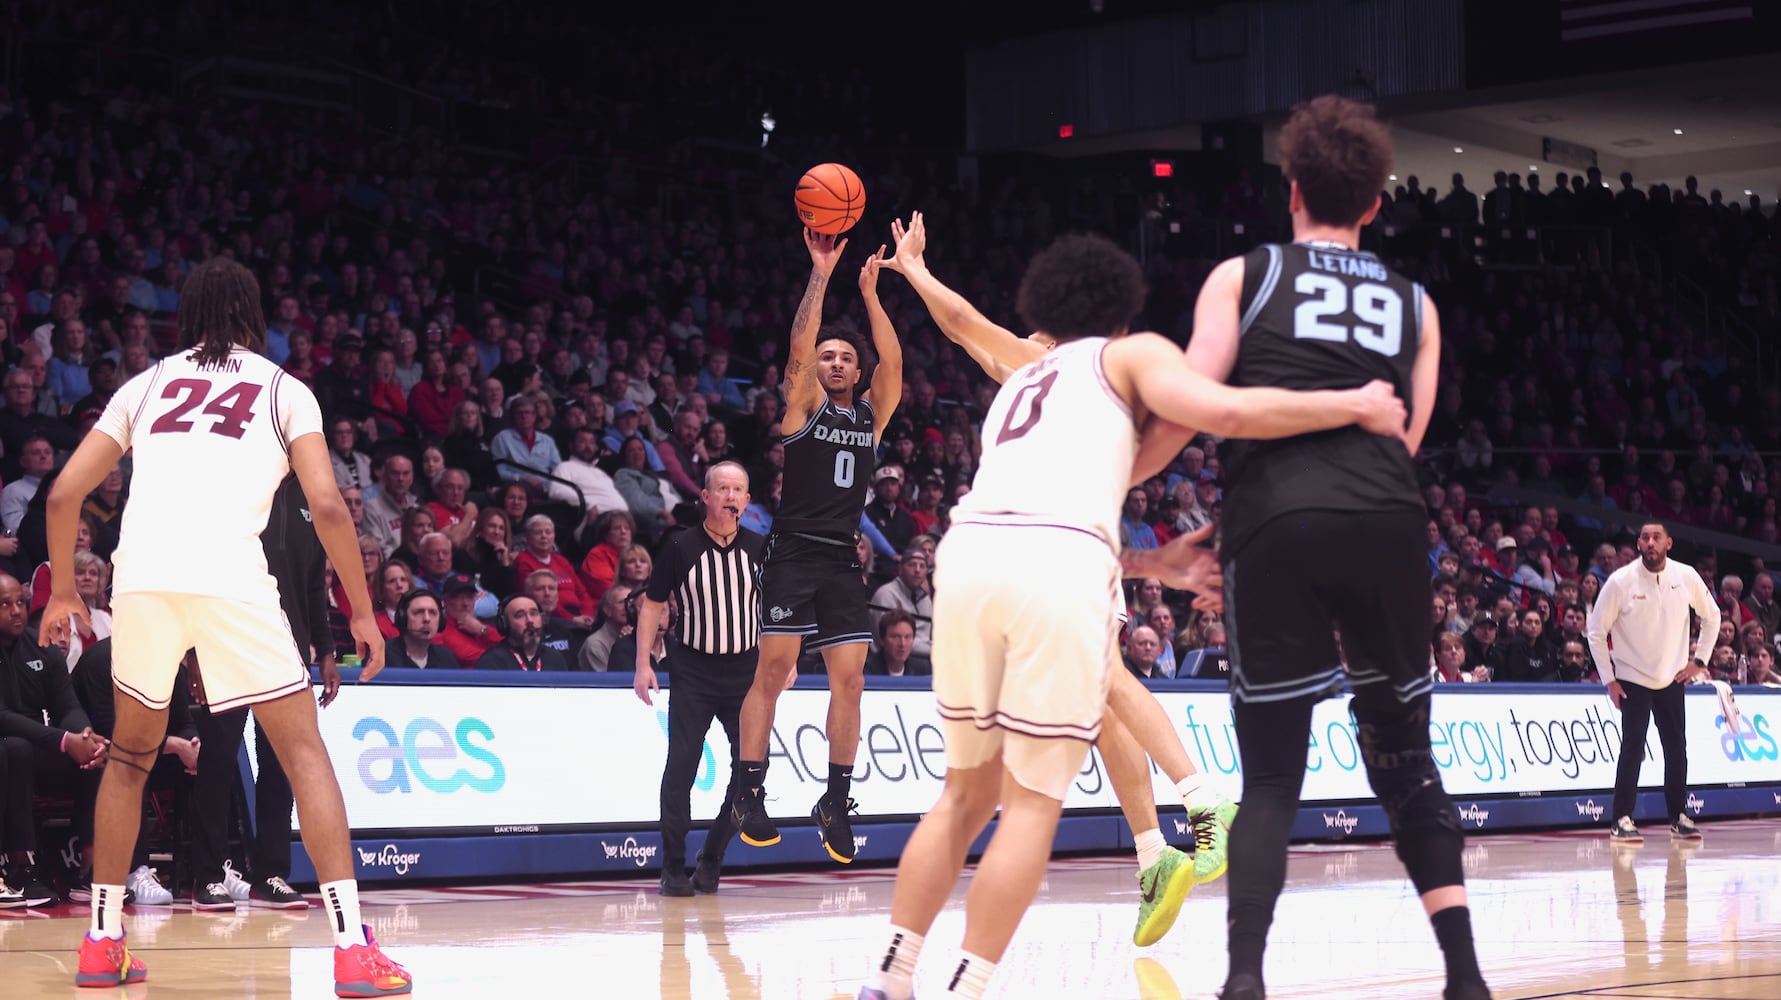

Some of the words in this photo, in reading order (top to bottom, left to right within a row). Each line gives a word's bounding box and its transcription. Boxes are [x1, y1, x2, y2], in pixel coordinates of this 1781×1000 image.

[1294, 271, 1403, 357] 29
[150, 377, 264, 441] 24
[995, 369, 1060, 448] 0
[813, 424, 873, 448] DAYTON
[833, 449, 856, 489] 0
[1714, 713, 1779, 763] aes
[352, 716, 507, 794] aes
[1334, 809, 1358, 834] Kroger
[1468, 803, 1490, 827] Kroger
[1582, 799, 1604, 822] Kroger
[494, 825, 540, 833] DAKTRONICS
[378, 844, 420, 875] Kroger
[619, 836, 657, 867] Kroger
